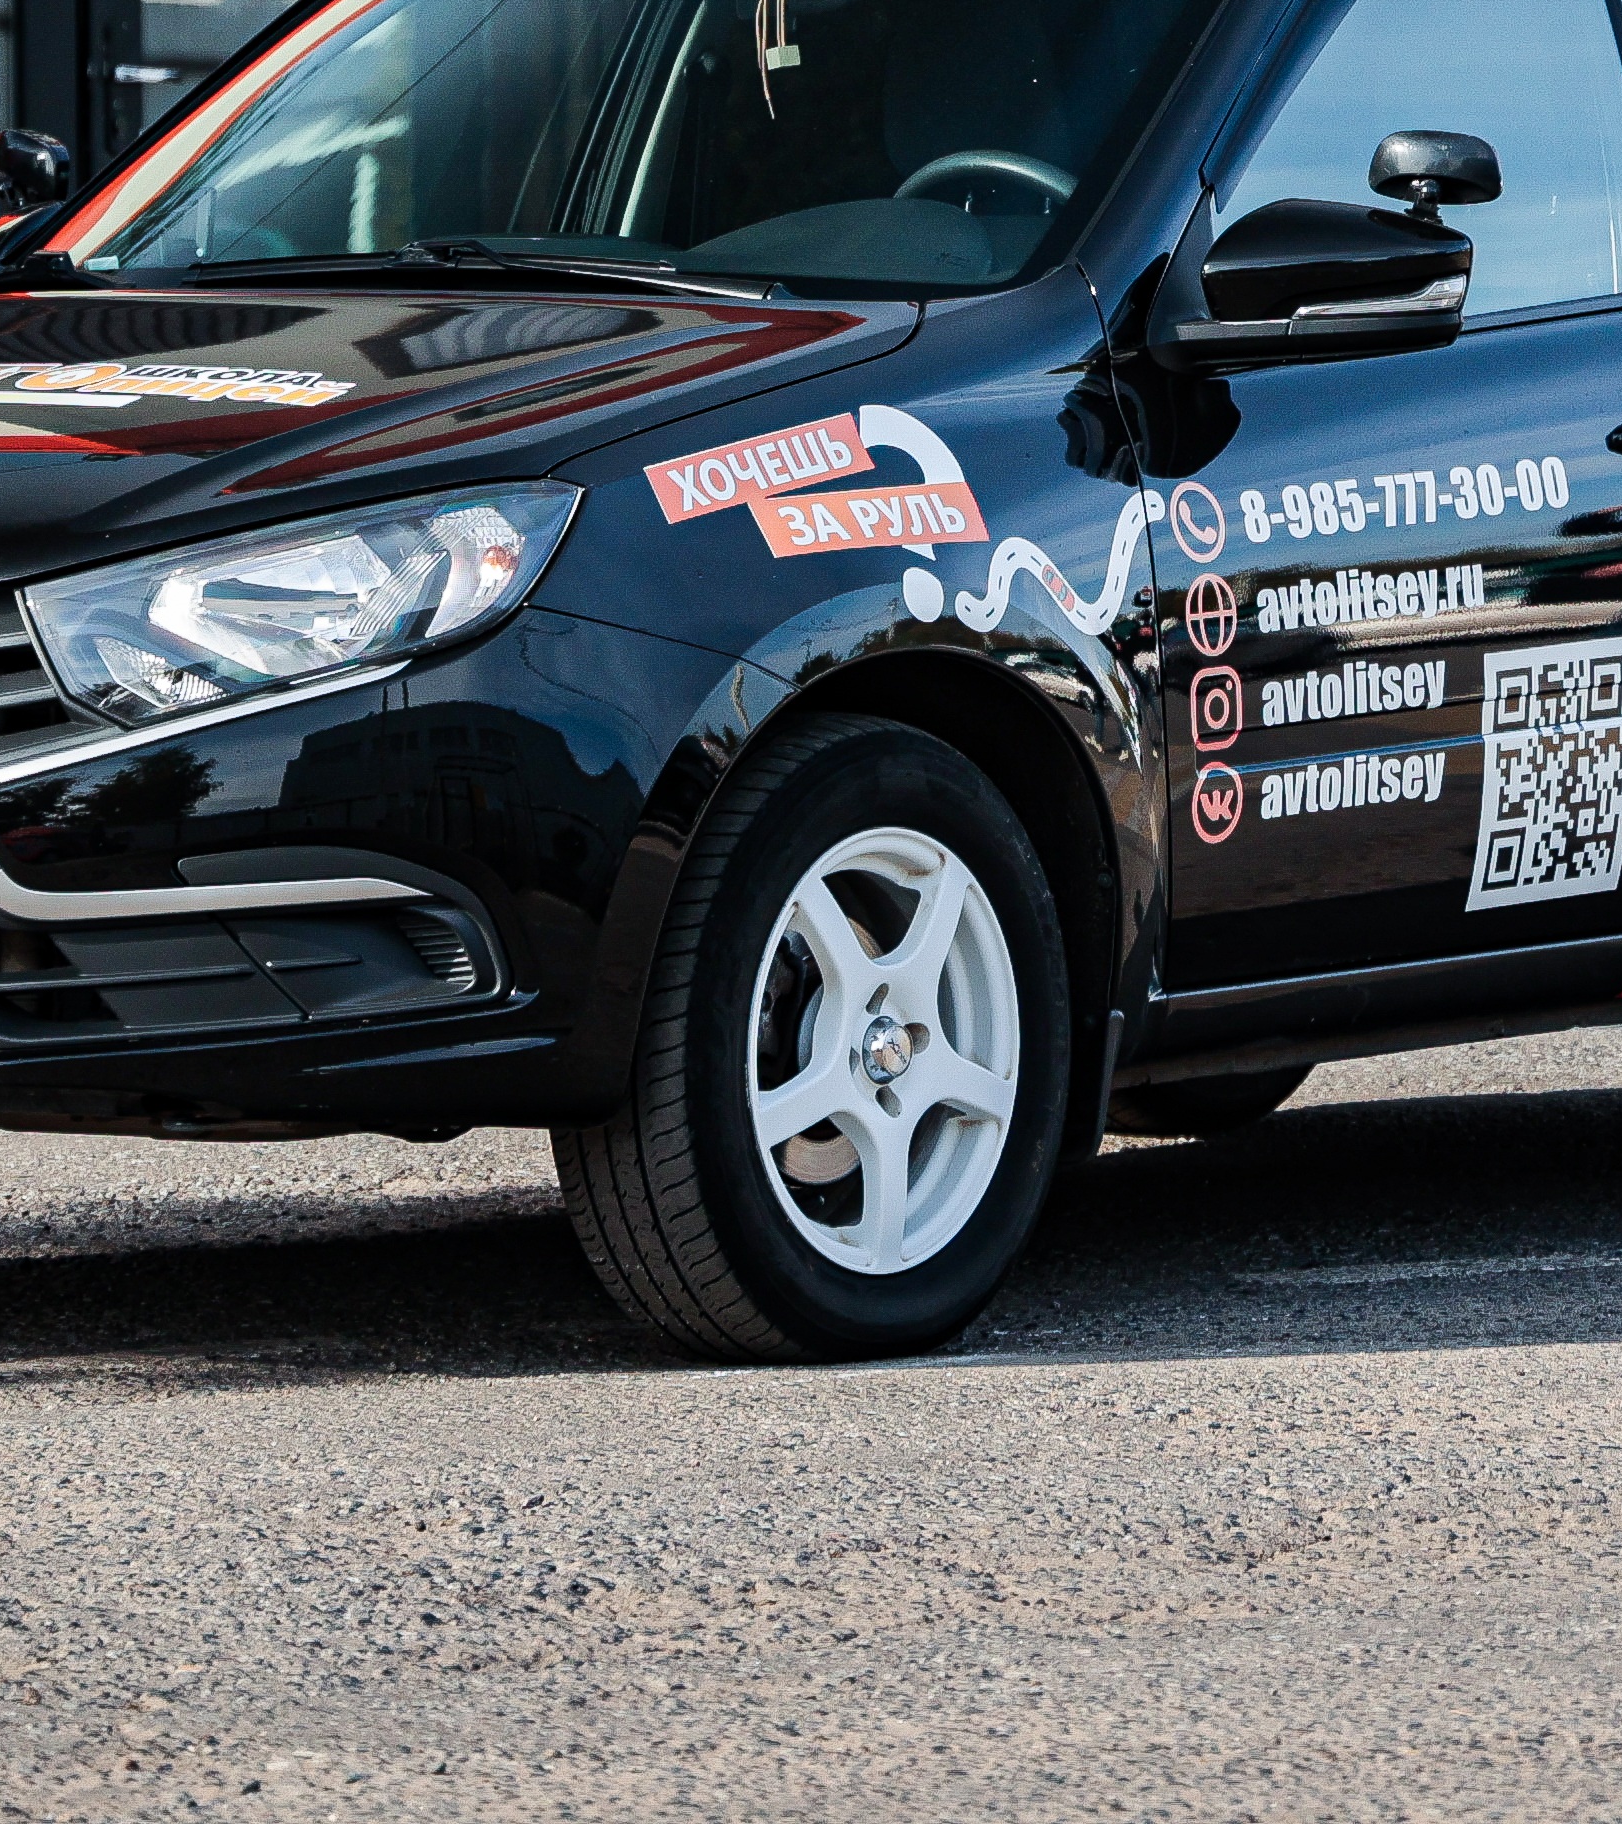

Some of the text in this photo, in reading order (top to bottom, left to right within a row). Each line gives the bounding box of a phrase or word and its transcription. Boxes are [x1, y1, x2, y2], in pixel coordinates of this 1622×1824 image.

[126, 364, 325, 388] ШКОЛА
[666, 428, 855, 512] ХОЧЕШЬ
[1239, 456, 1571, 544] 8-985-777-30-00
[777, 494, 967, 547] ЗА РУЛЬ
[1256, 564, 1486, 634] avtolitsey.ru
[1261, 659, 1447, 728] avtolitsey
[1260, 750, 1446, 821] avtolitsey
